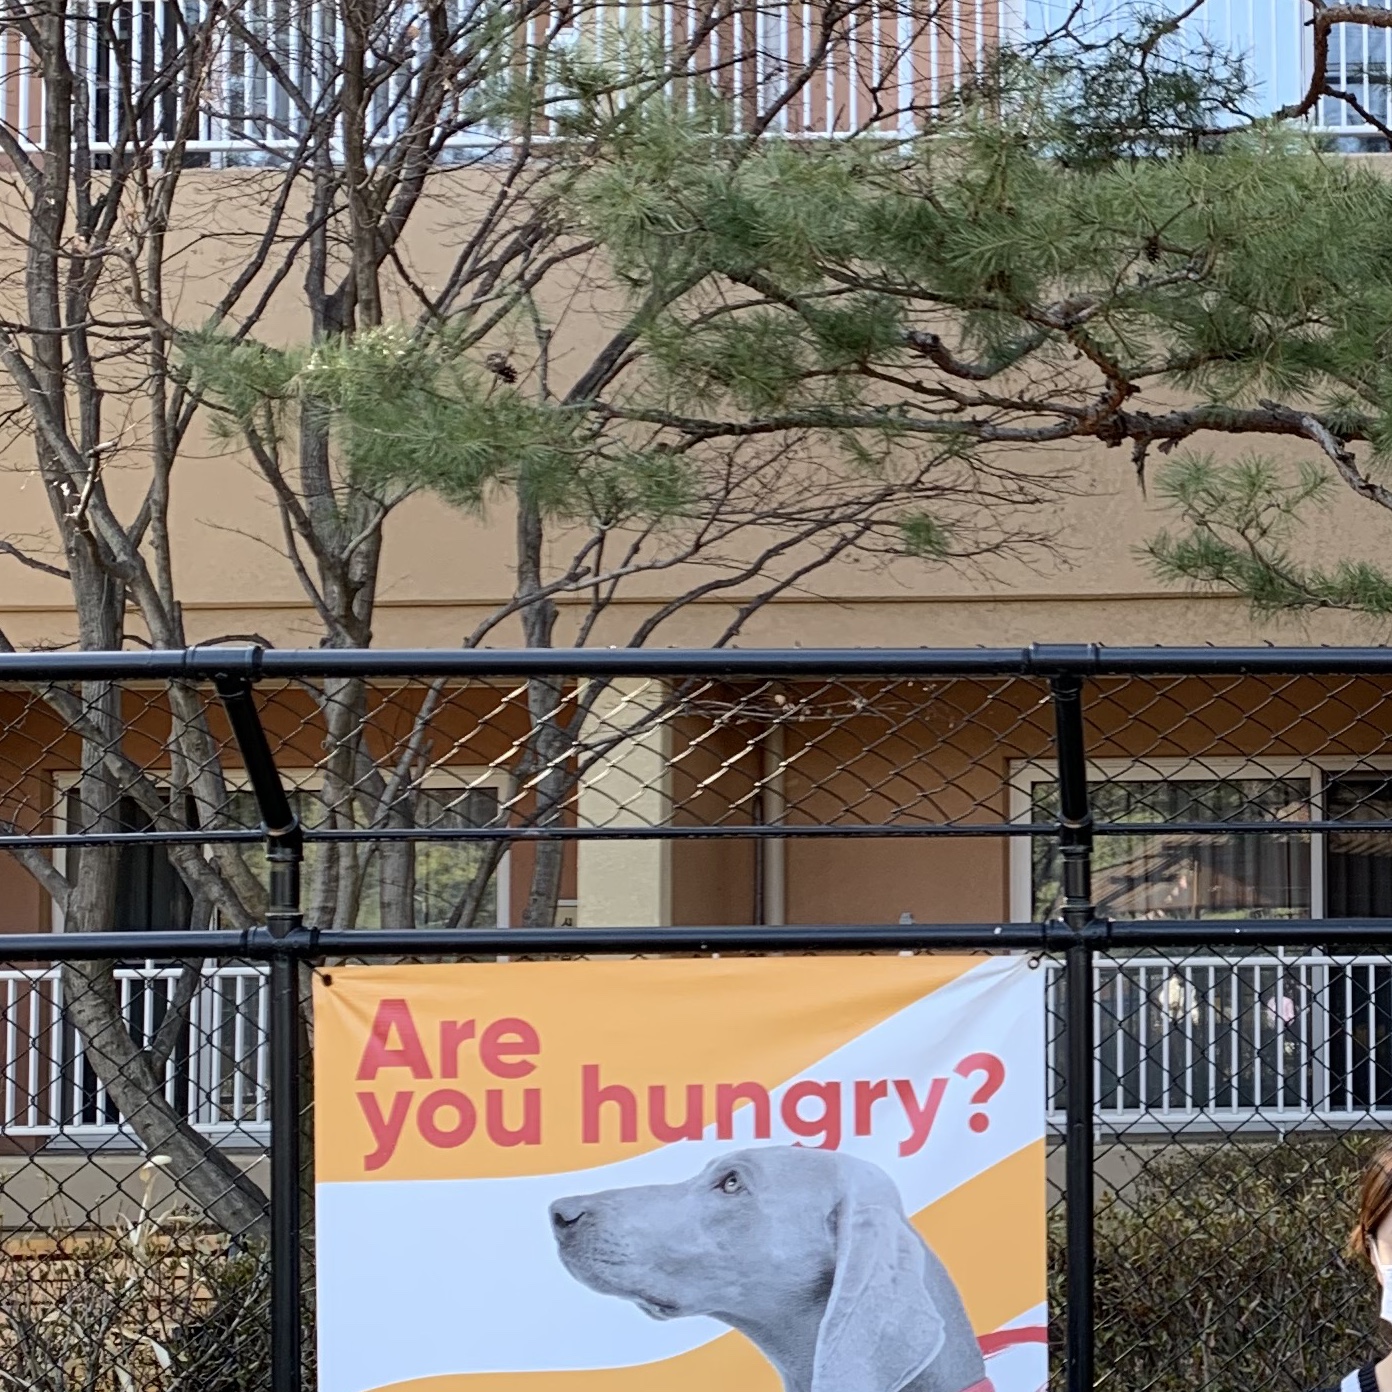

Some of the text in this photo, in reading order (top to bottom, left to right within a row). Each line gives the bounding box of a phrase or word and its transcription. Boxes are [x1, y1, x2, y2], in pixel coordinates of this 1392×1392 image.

[356, 998, 541, 1081] Are
[356, 1053, 1006, 1172] you hungry?
